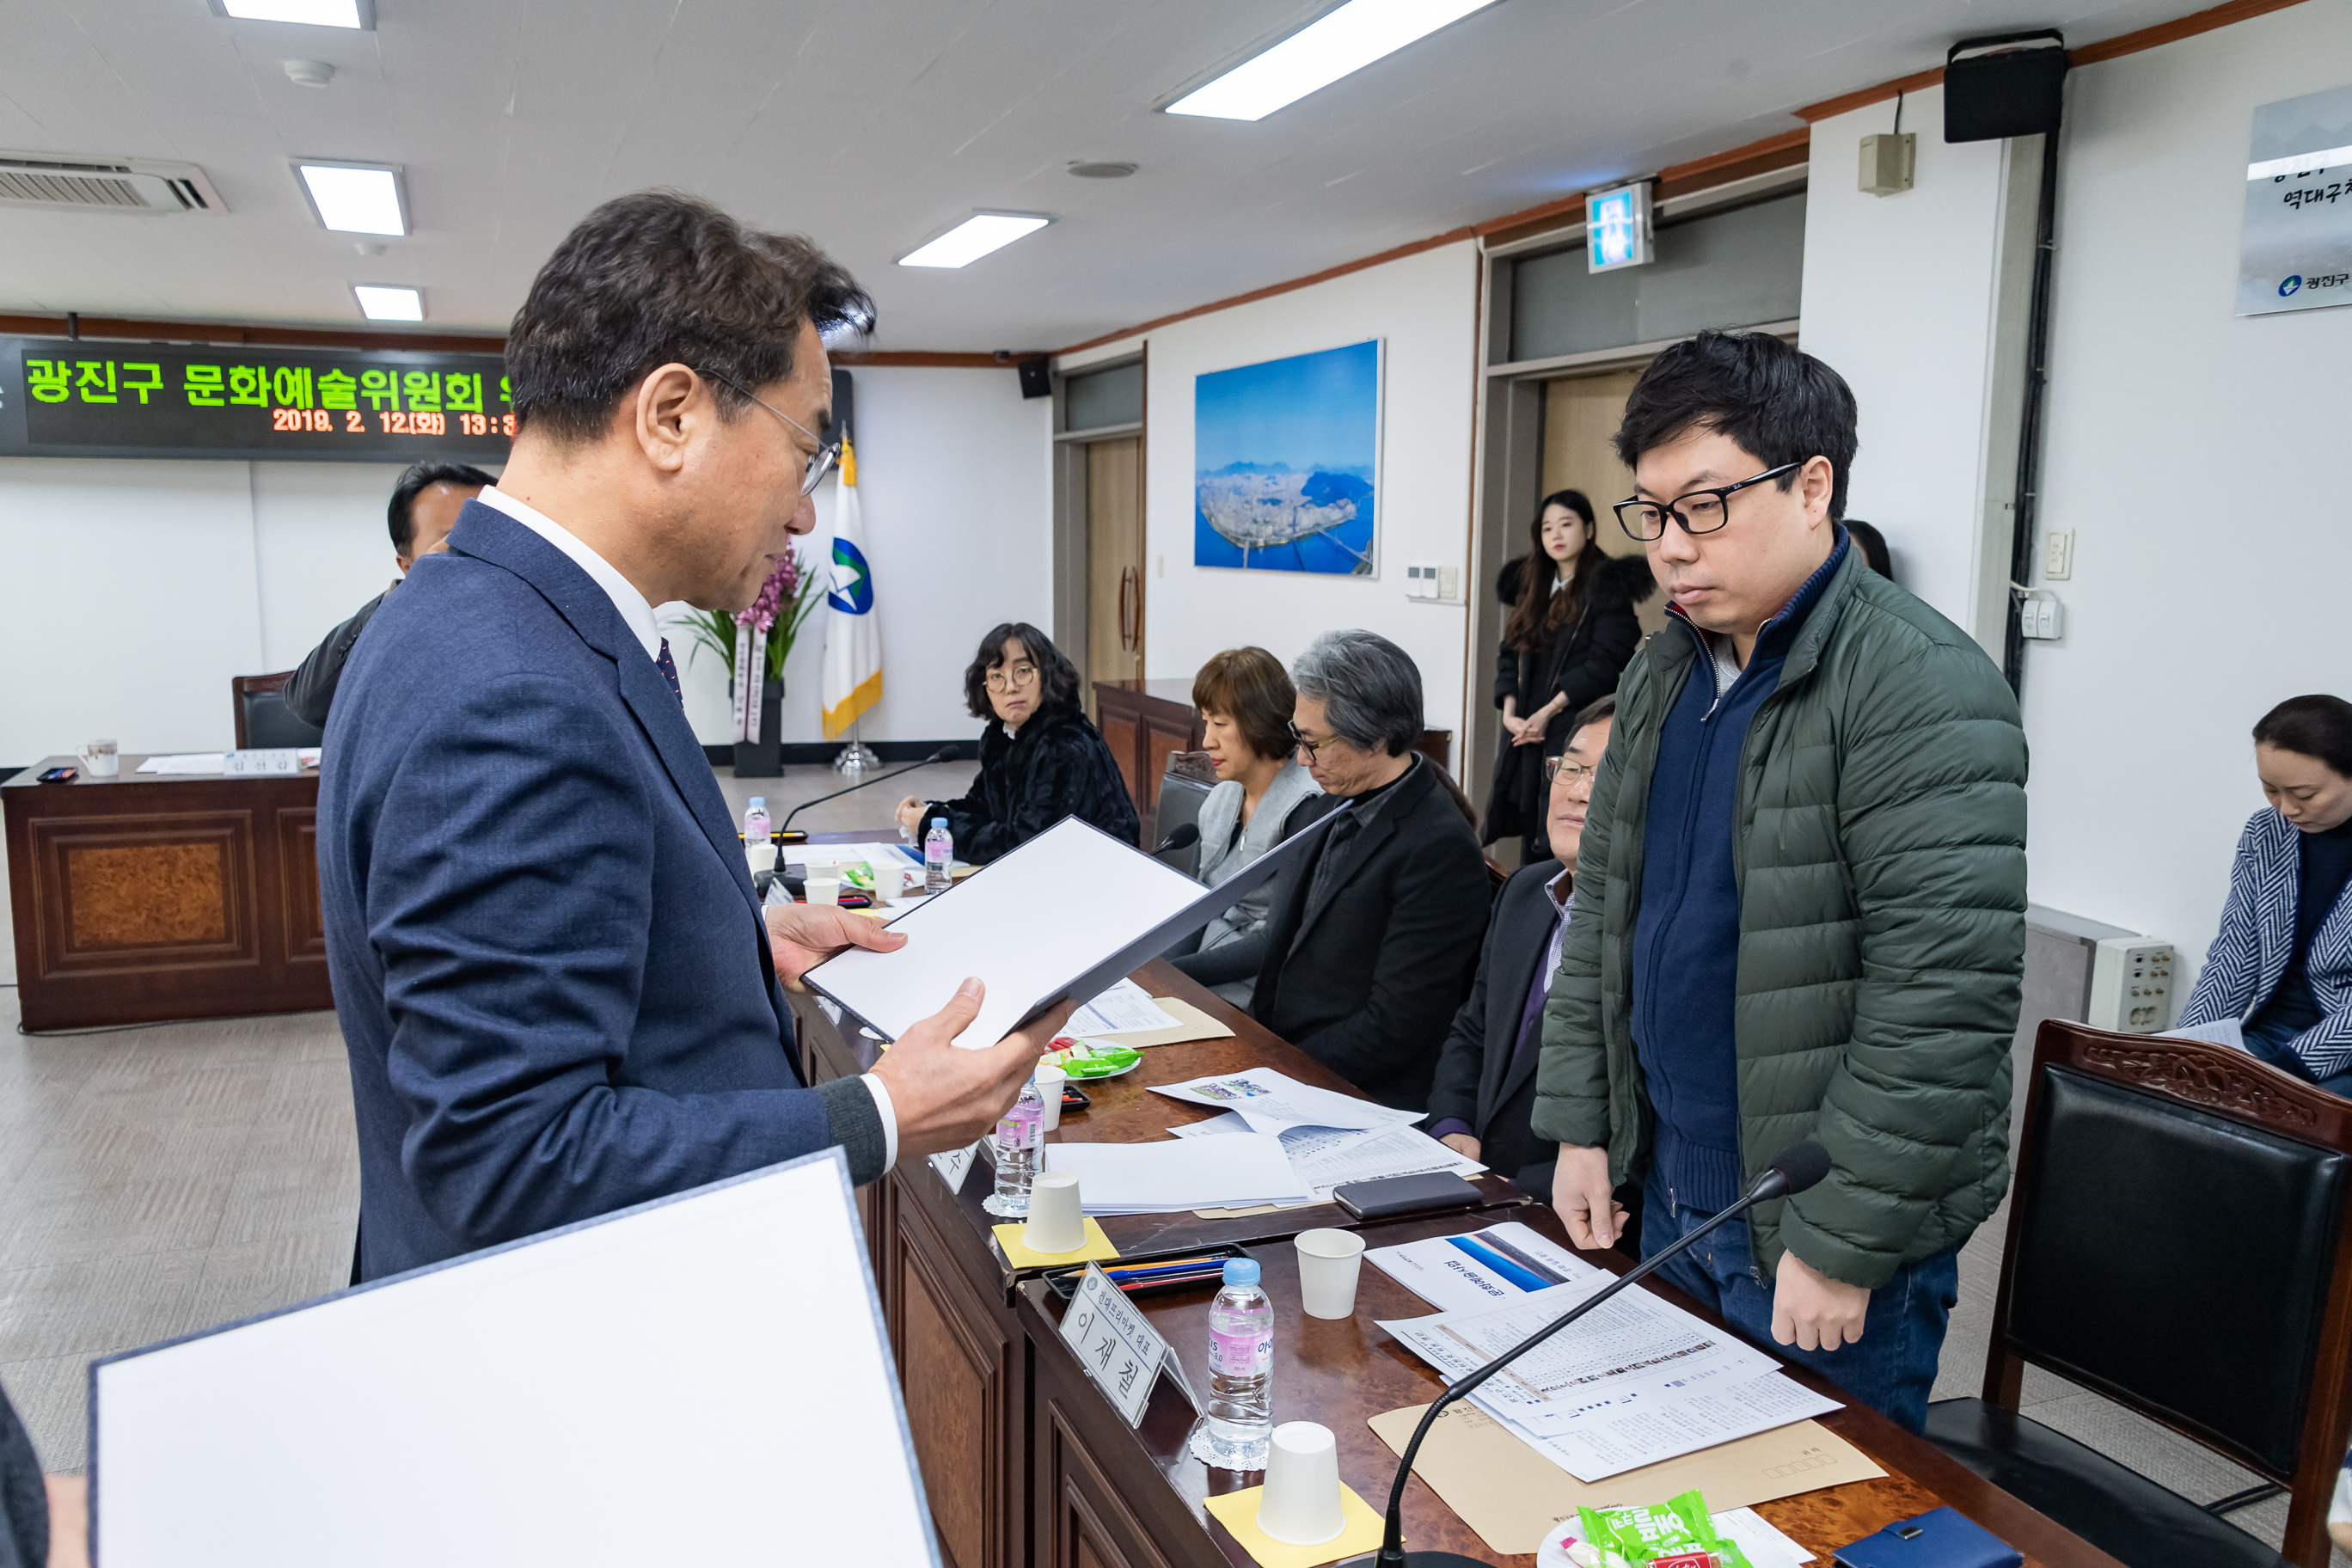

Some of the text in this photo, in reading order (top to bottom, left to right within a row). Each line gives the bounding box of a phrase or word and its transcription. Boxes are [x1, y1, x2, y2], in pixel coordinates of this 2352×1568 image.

[2306, 273, 2349, 290] 광진구
[27, 359, 164, 405] 광진구
[184, 364, 483, 413] 문화예술위원회
[273, 408, 333, 432] 2019.
[346, 410, 365, 432] 2.
[379, 411, 446, 436] 12.(화)
[1099, 1290, 1151, 1356] 건대프리마켓 대표
